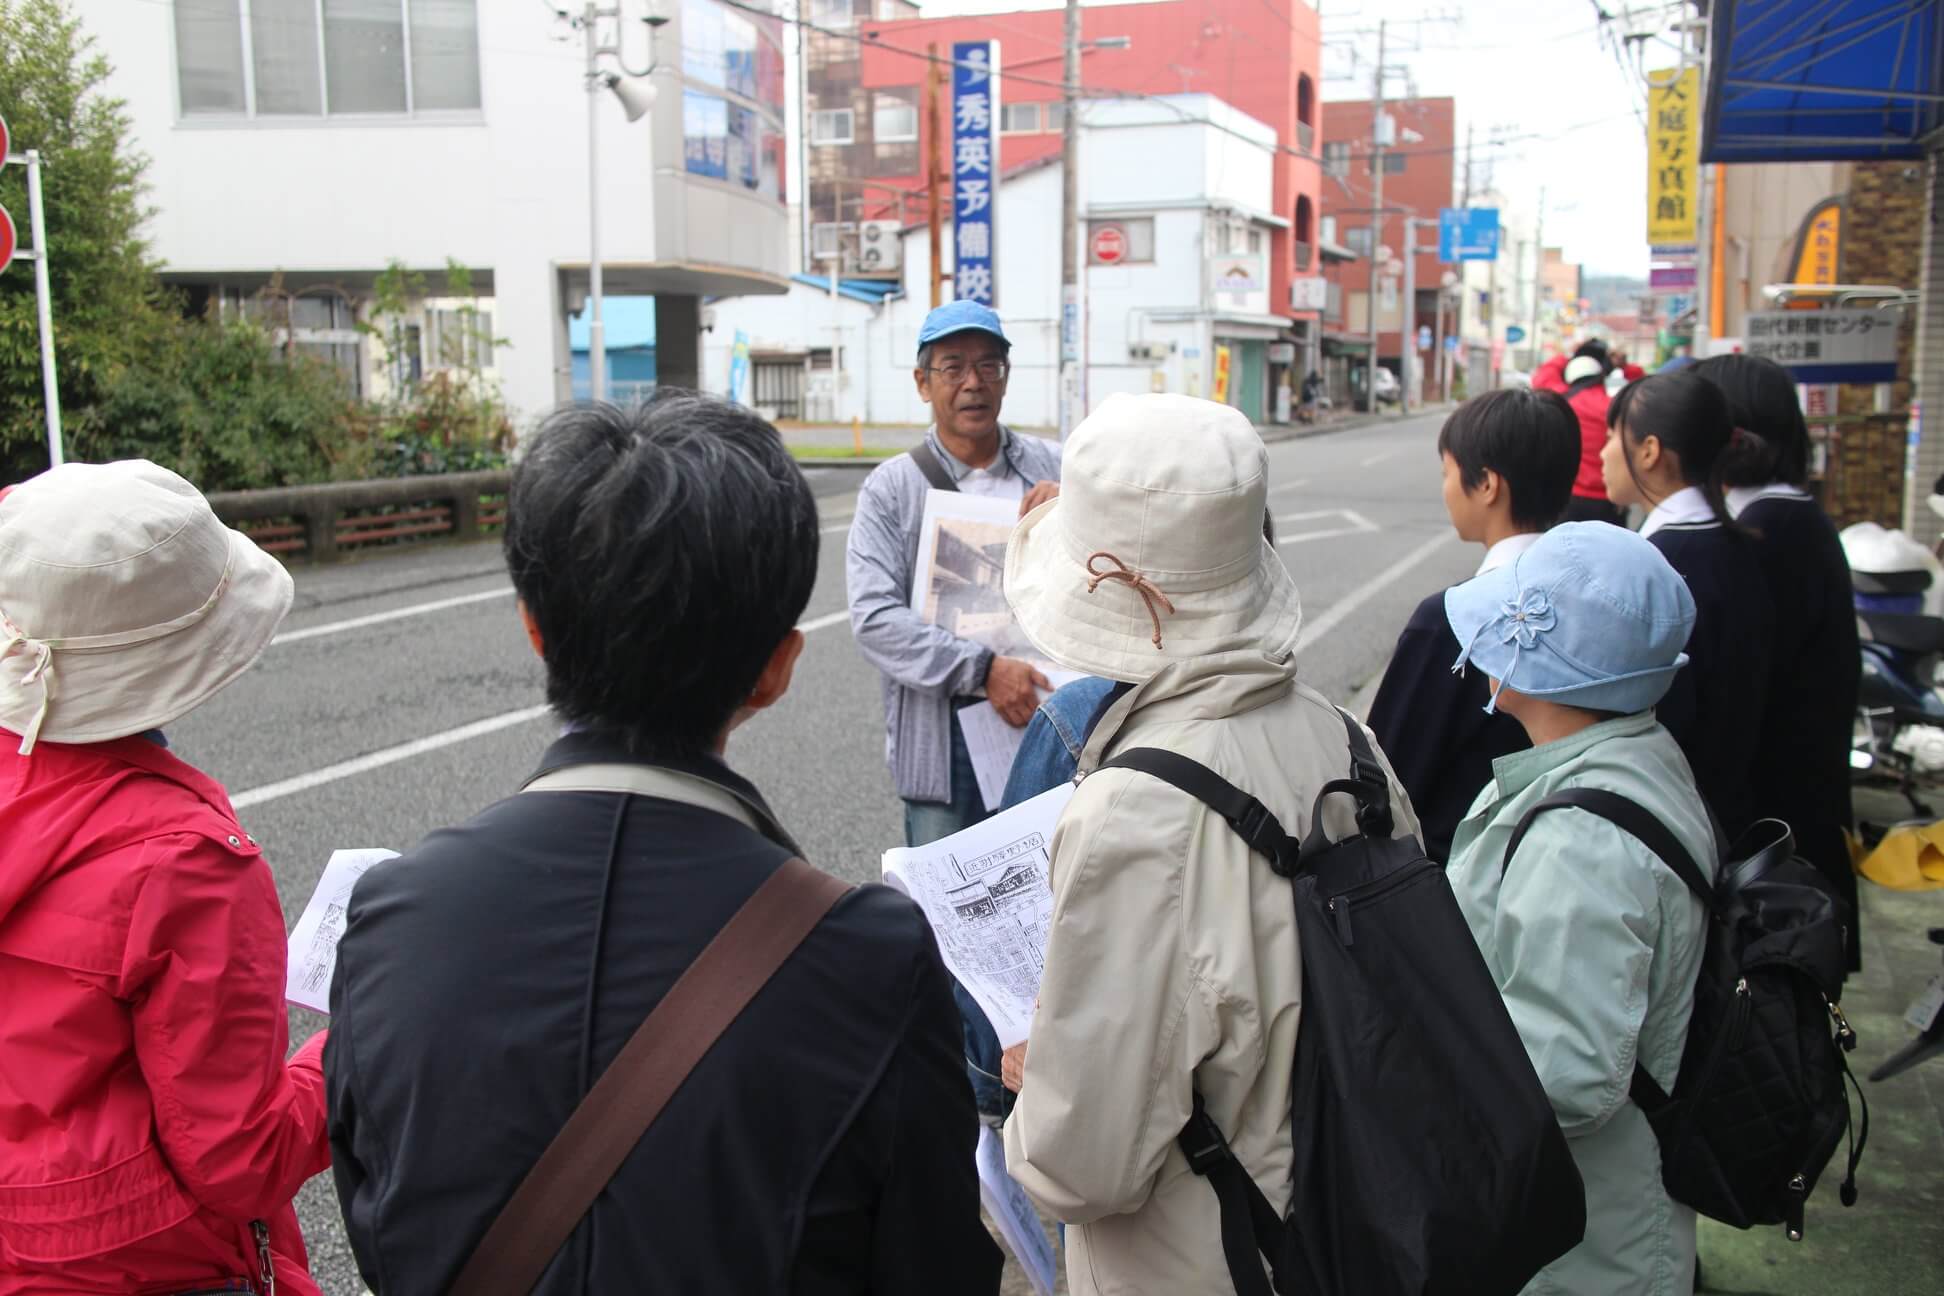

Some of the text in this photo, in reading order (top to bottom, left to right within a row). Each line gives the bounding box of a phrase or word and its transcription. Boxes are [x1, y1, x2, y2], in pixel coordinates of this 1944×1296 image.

[956, 93, 991, 299] 秀英予備校
